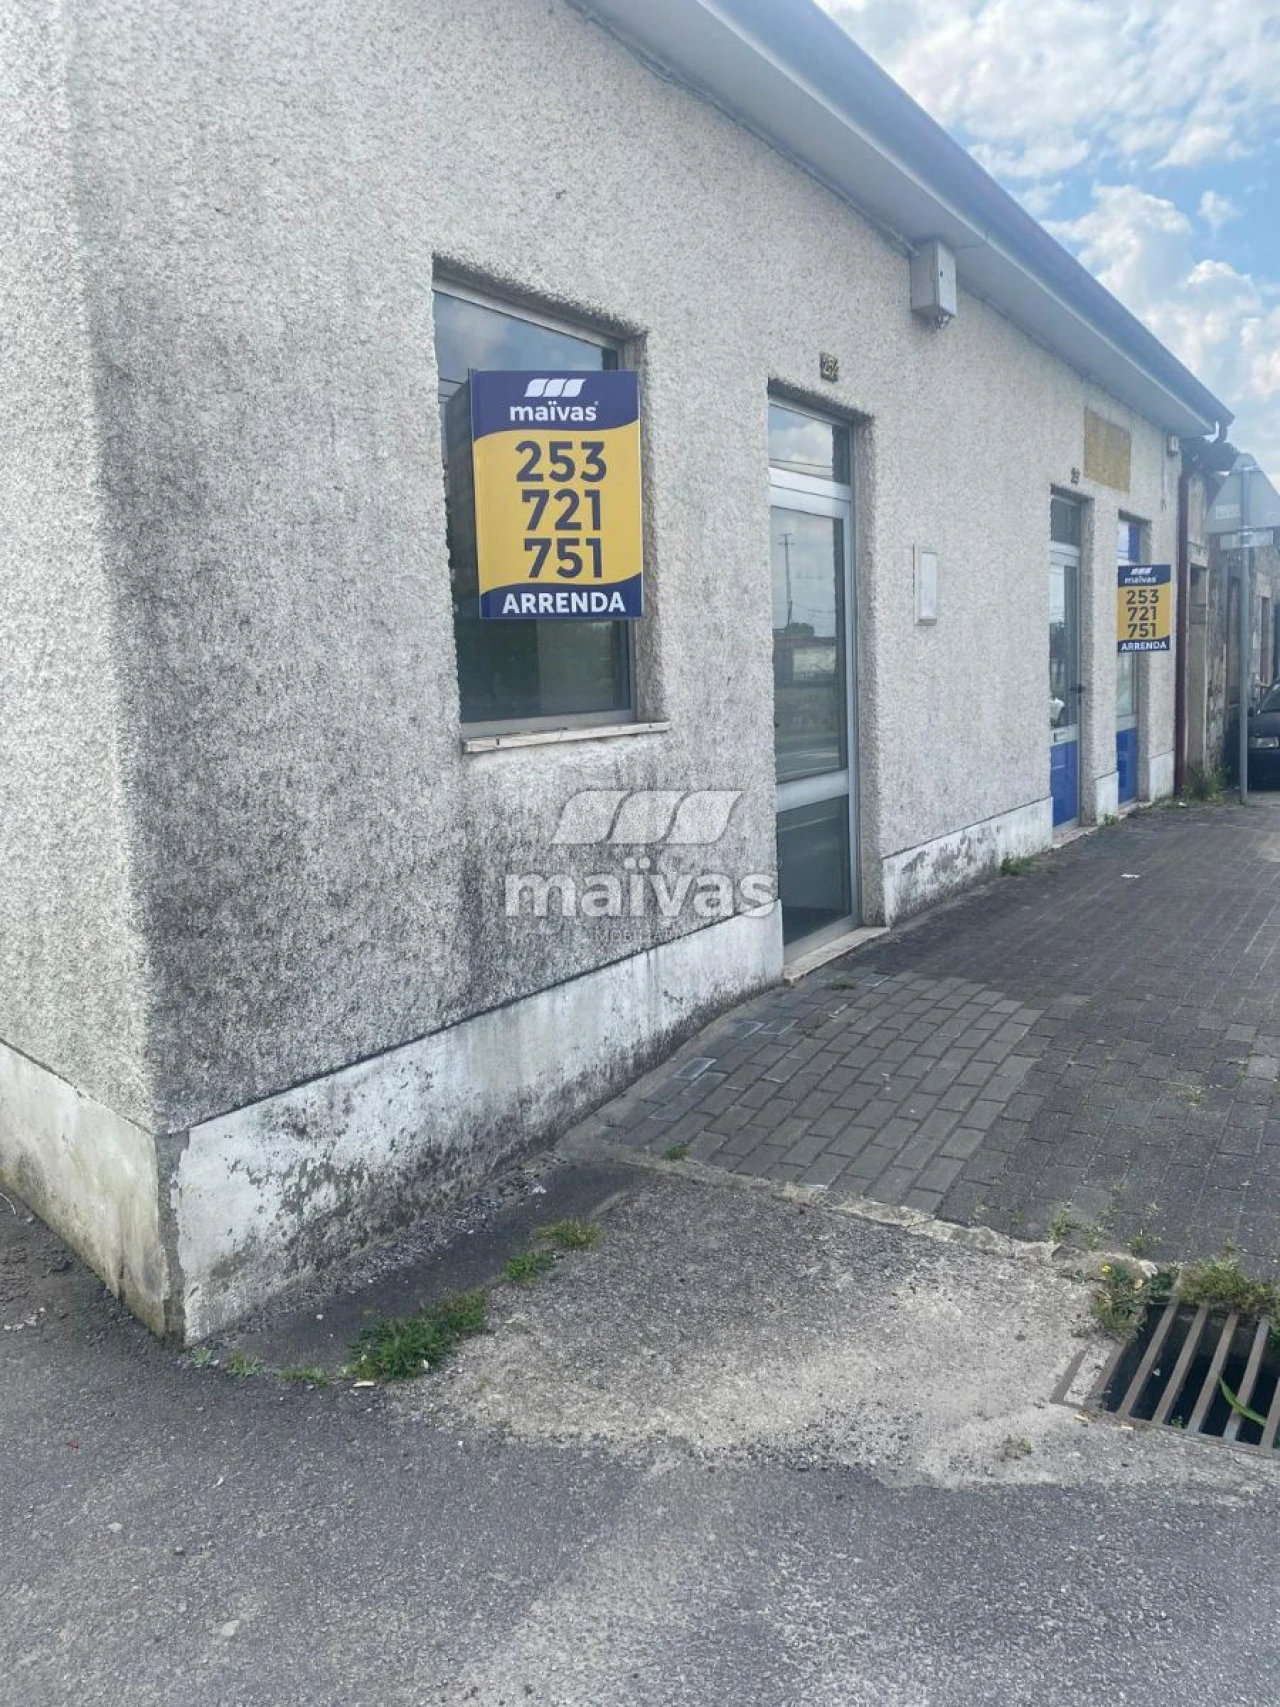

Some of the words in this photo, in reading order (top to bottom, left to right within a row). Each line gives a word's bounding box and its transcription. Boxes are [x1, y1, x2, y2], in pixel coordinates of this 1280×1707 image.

[510, 401, 597, 421] maïvas
[515, 441, 607, 482] 253
[521, 489, 601, 531] 721
[523, 538, 603, 578] 751
[502, 592, 626, 613] ARRENDA
[1126, 589, 1159, 605] 253
[1128, 606, 1157, 621] 721
[1128, 623, 1156, 637] 751
[1121, 642, 1167, 651] ARRENDA
